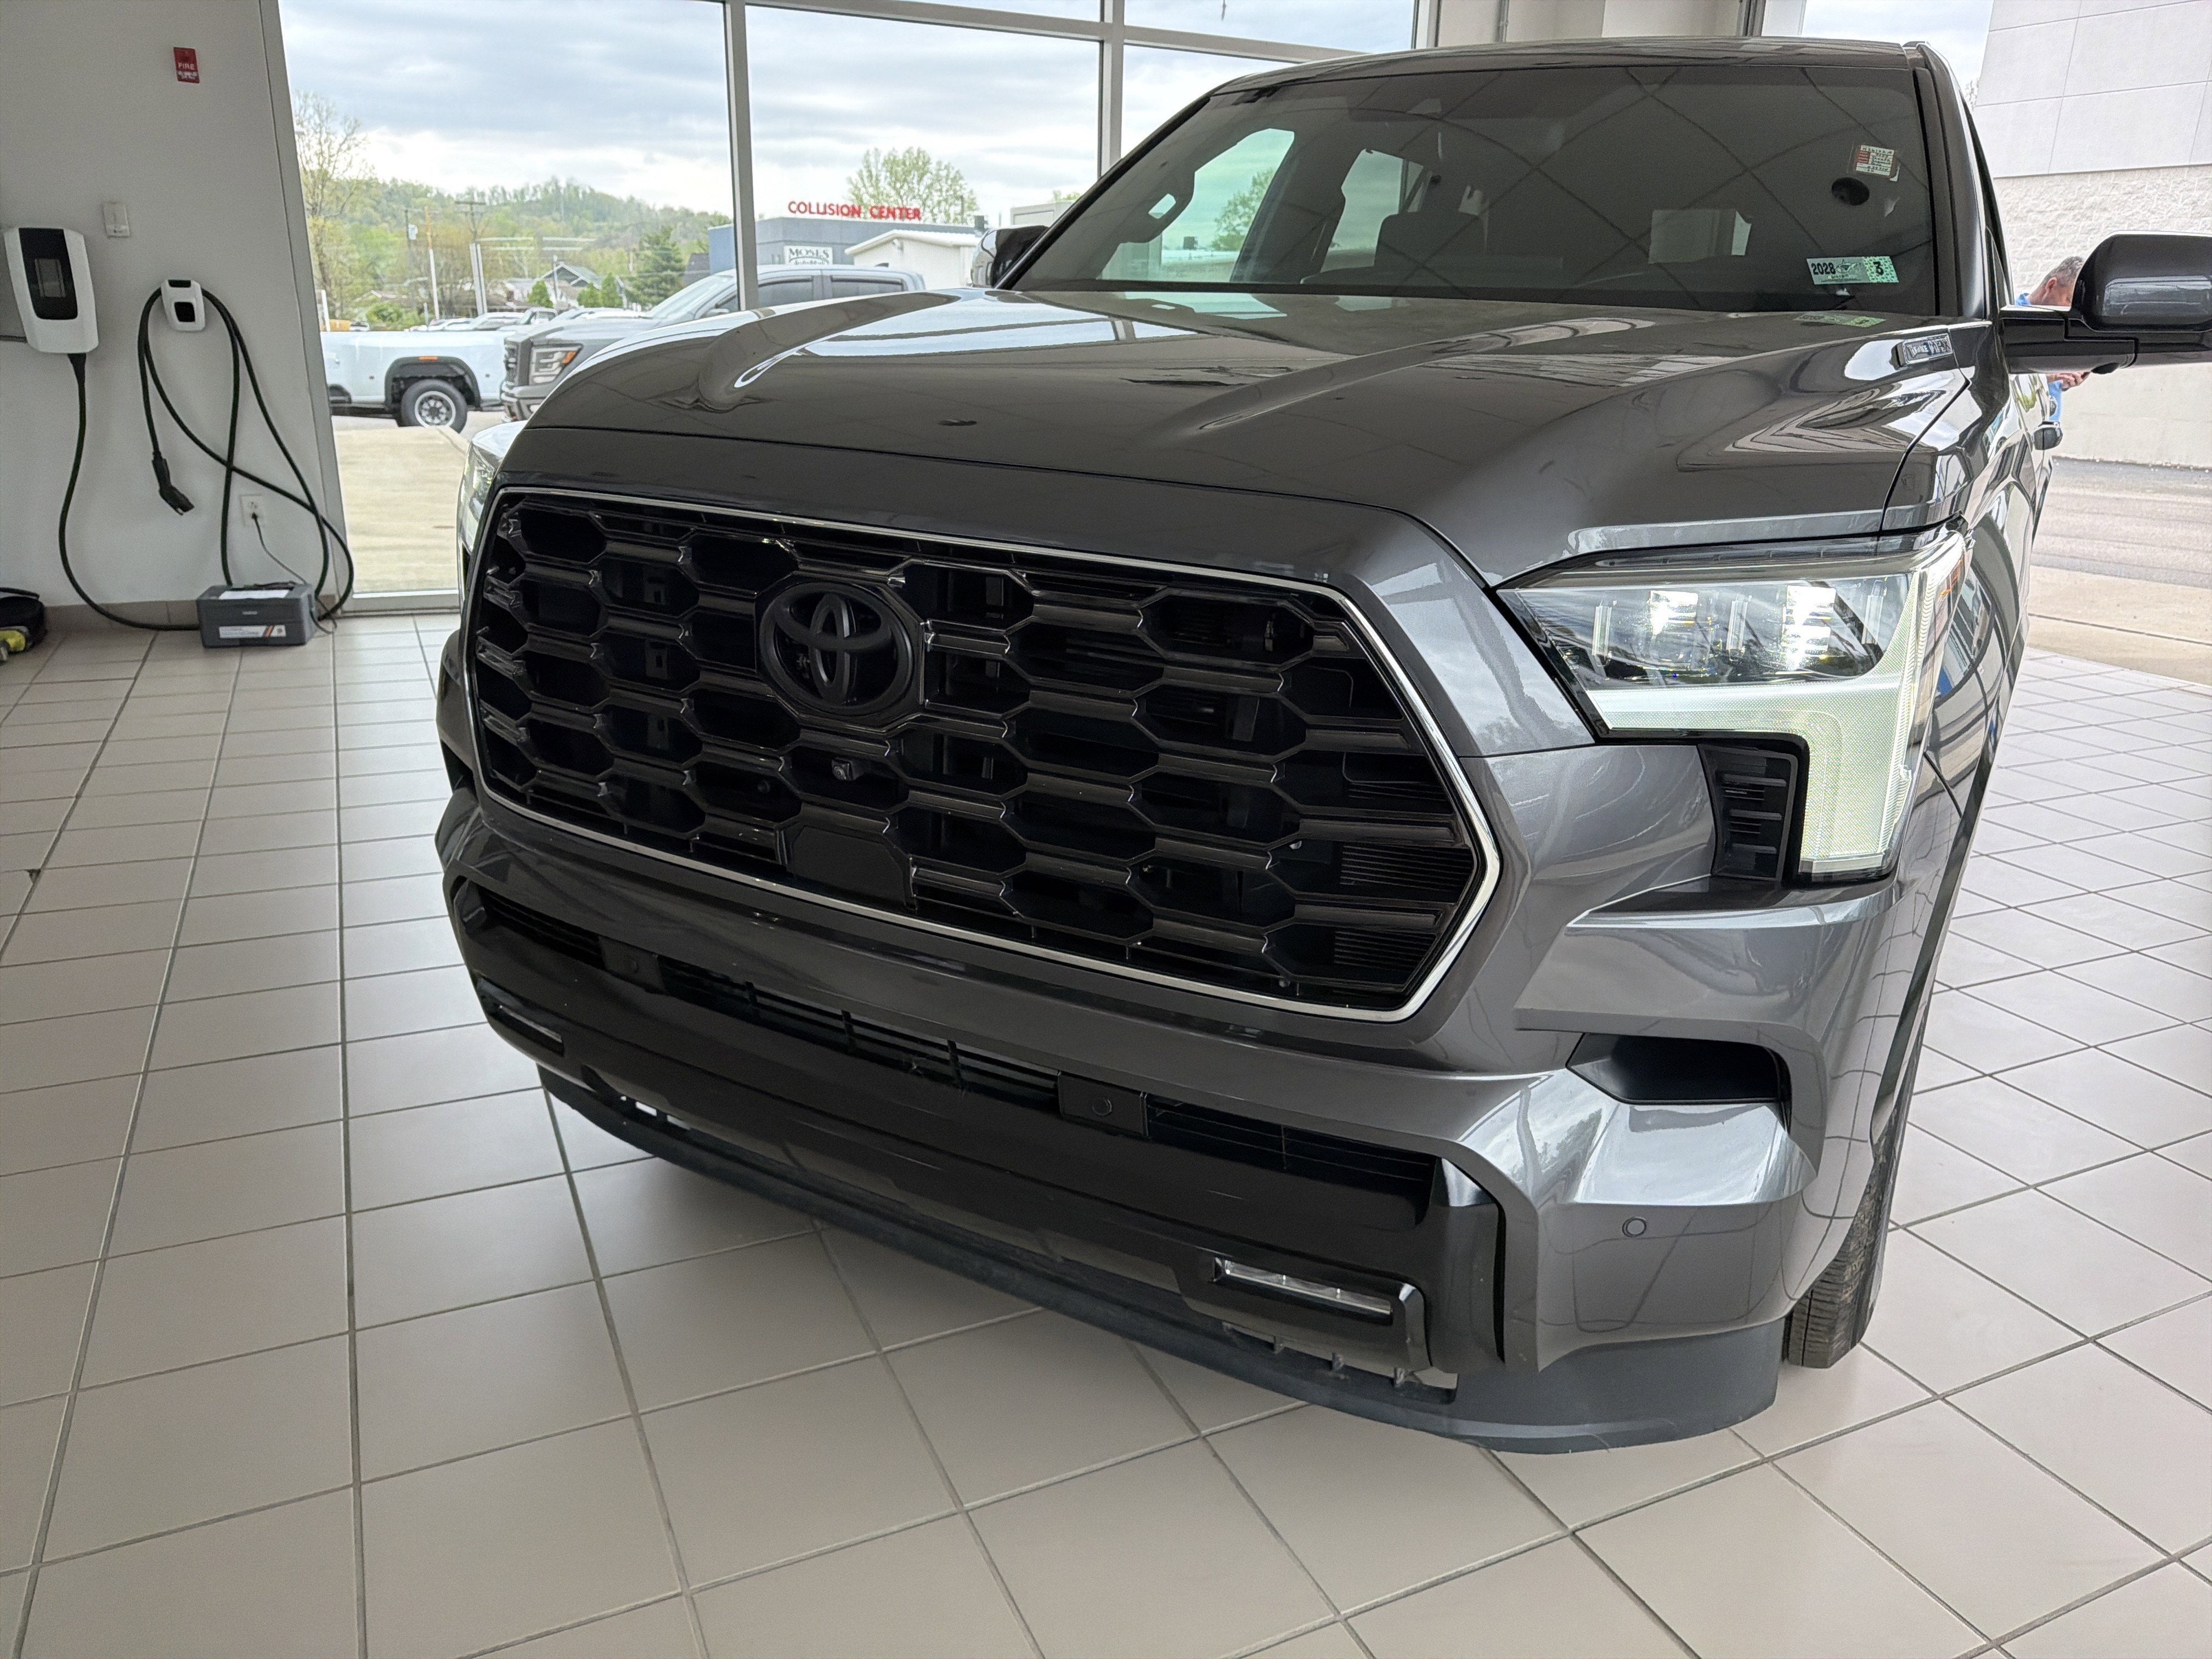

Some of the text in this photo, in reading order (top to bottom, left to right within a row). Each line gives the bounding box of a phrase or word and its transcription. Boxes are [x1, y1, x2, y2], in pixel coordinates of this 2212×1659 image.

[788, 201, 922, 221] COLLISION CENTER
[1811, 262, 1836, 275] 2028
[1873, 261, 1884, 275] 3
